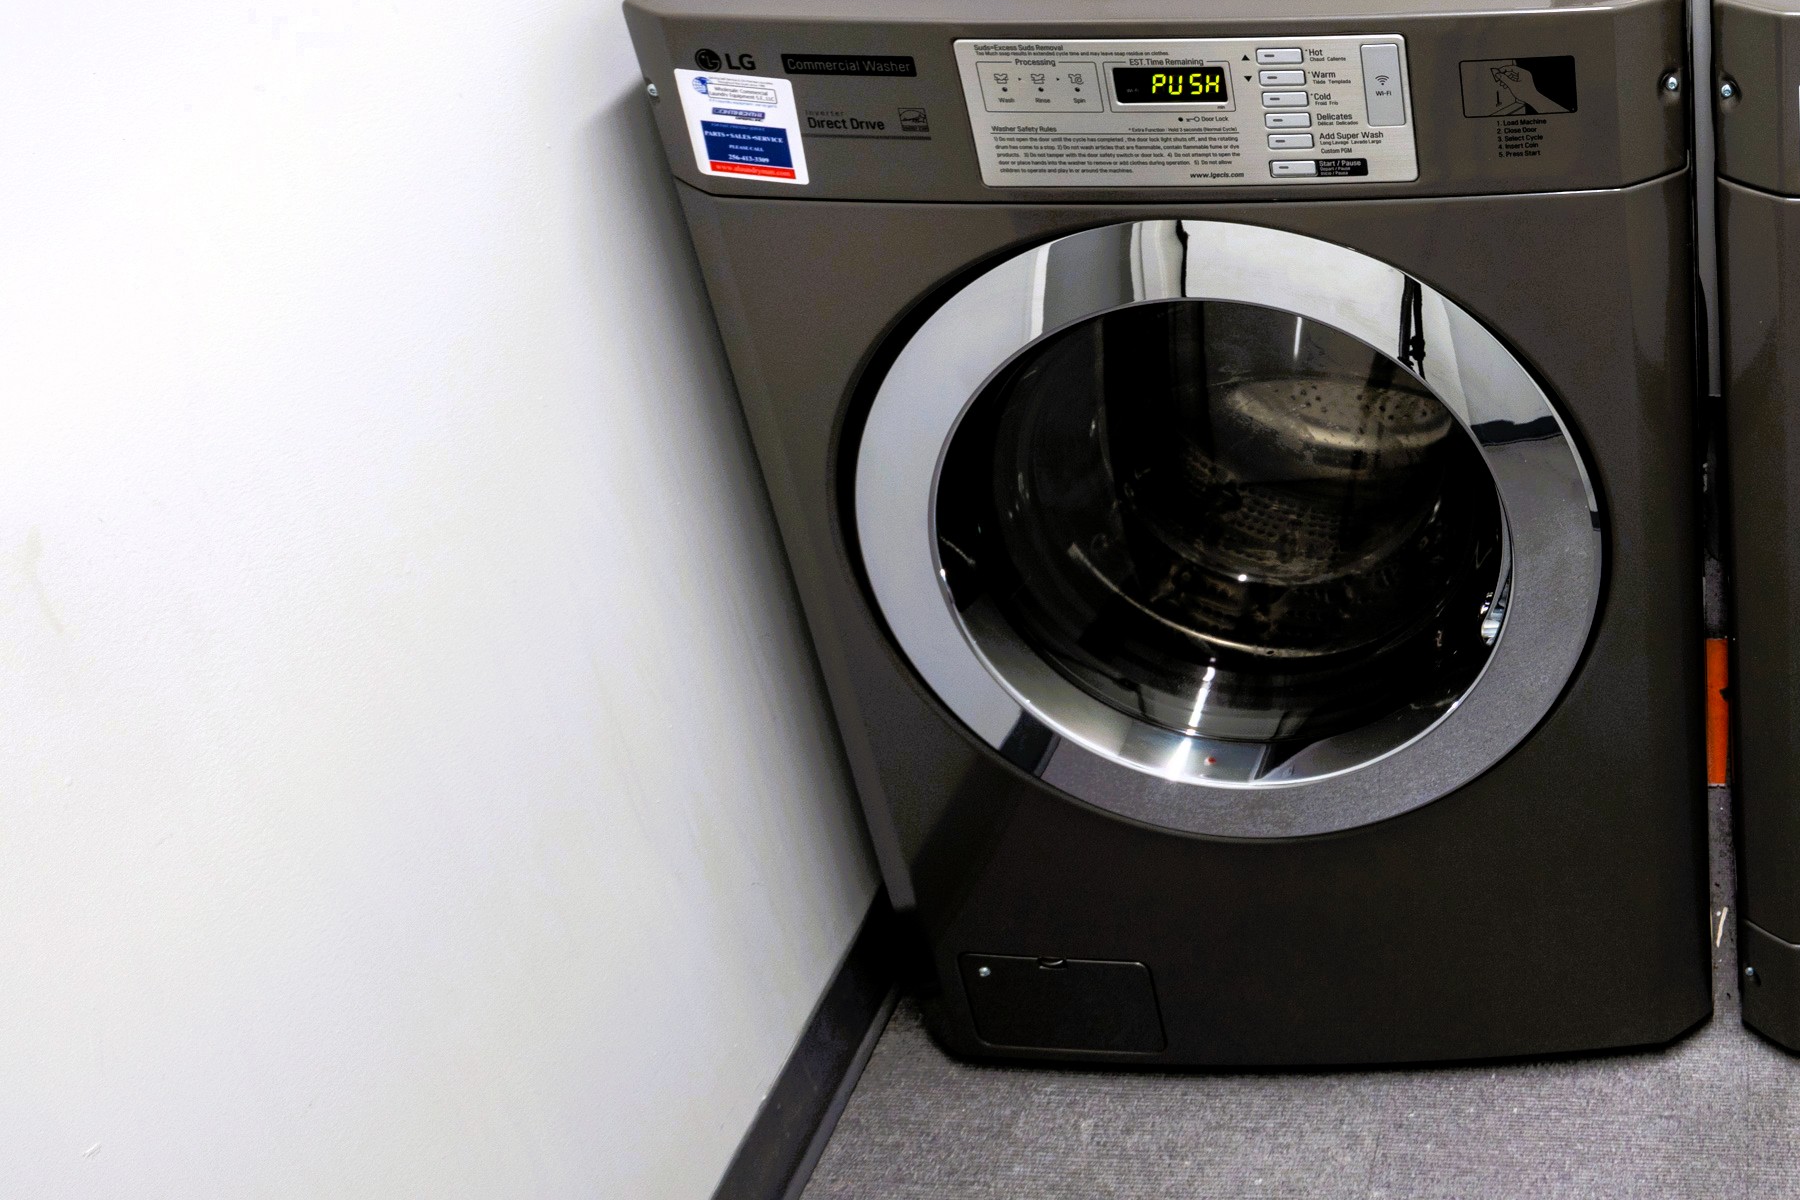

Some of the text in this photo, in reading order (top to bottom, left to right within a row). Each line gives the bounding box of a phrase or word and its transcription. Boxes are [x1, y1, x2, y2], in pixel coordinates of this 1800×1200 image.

[725, 54, 756, 70] LG
[788, 60, 909, 71] Commercial Washer
[1152, 74, 1219, 95] PUSH
[808, 118, 885, 130] Direct Drive
